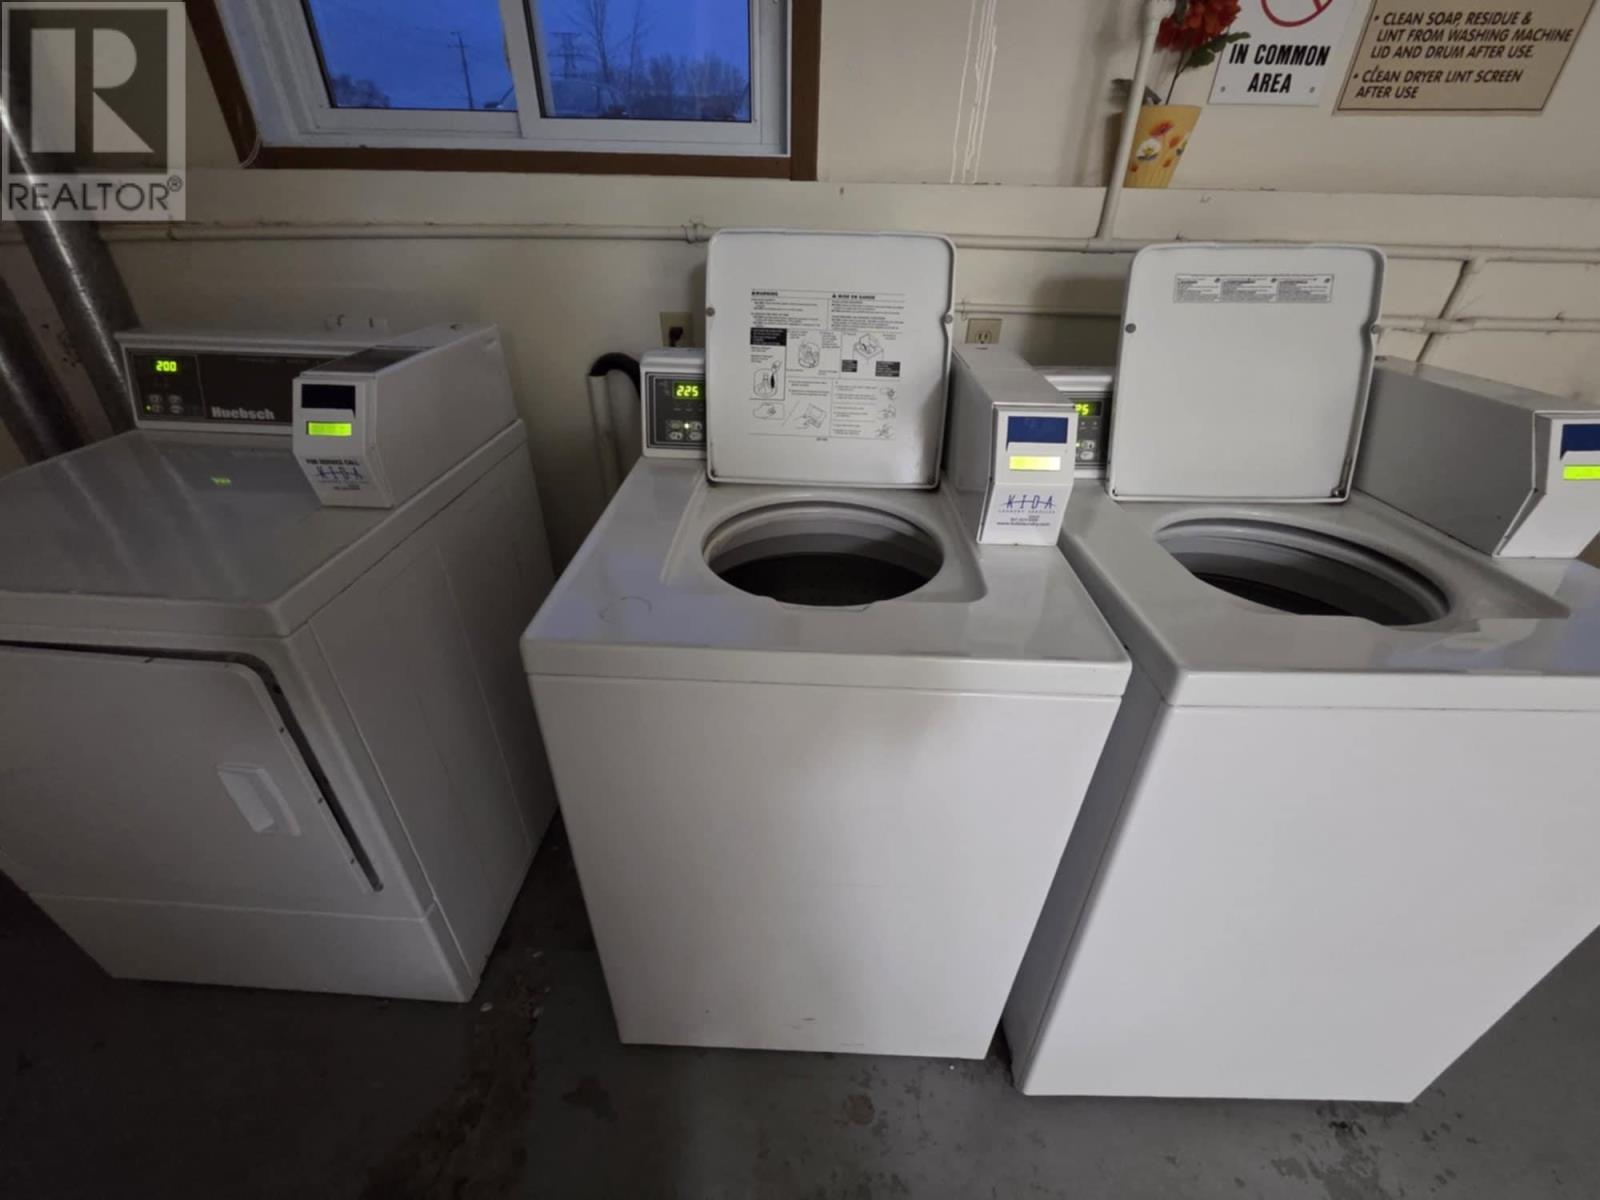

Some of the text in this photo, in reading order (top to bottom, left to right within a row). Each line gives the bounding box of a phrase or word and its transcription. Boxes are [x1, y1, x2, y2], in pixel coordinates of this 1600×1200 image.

[1383, 11, 1533, 27] CLEAN SOAP, RESIDUE &
[1376, 28, 1574, 42] LINT FROM WASHING MACHINE
[1229, 43, 1332, 66] IN COMMON
[1370, 45, 1391, 59] LID
[1392, 45, 1422, 59] AND
[1425, 45, 1465, 59] DRUM
[1466, 45, 1505, 58] AFTER
[1362, 65, 1524, 83] CLEAN DRYER LINT SCREEN
[1247, 73, 1293, 93] AREA
[1355, 85, 1420, 99] AFTER USE
[156, 360, 177, 372] 200
[676, 385, 699, 397] 225
[211, 405, 275, 420] Huebsch
[1005, 494, 1054, 509] KIDA
